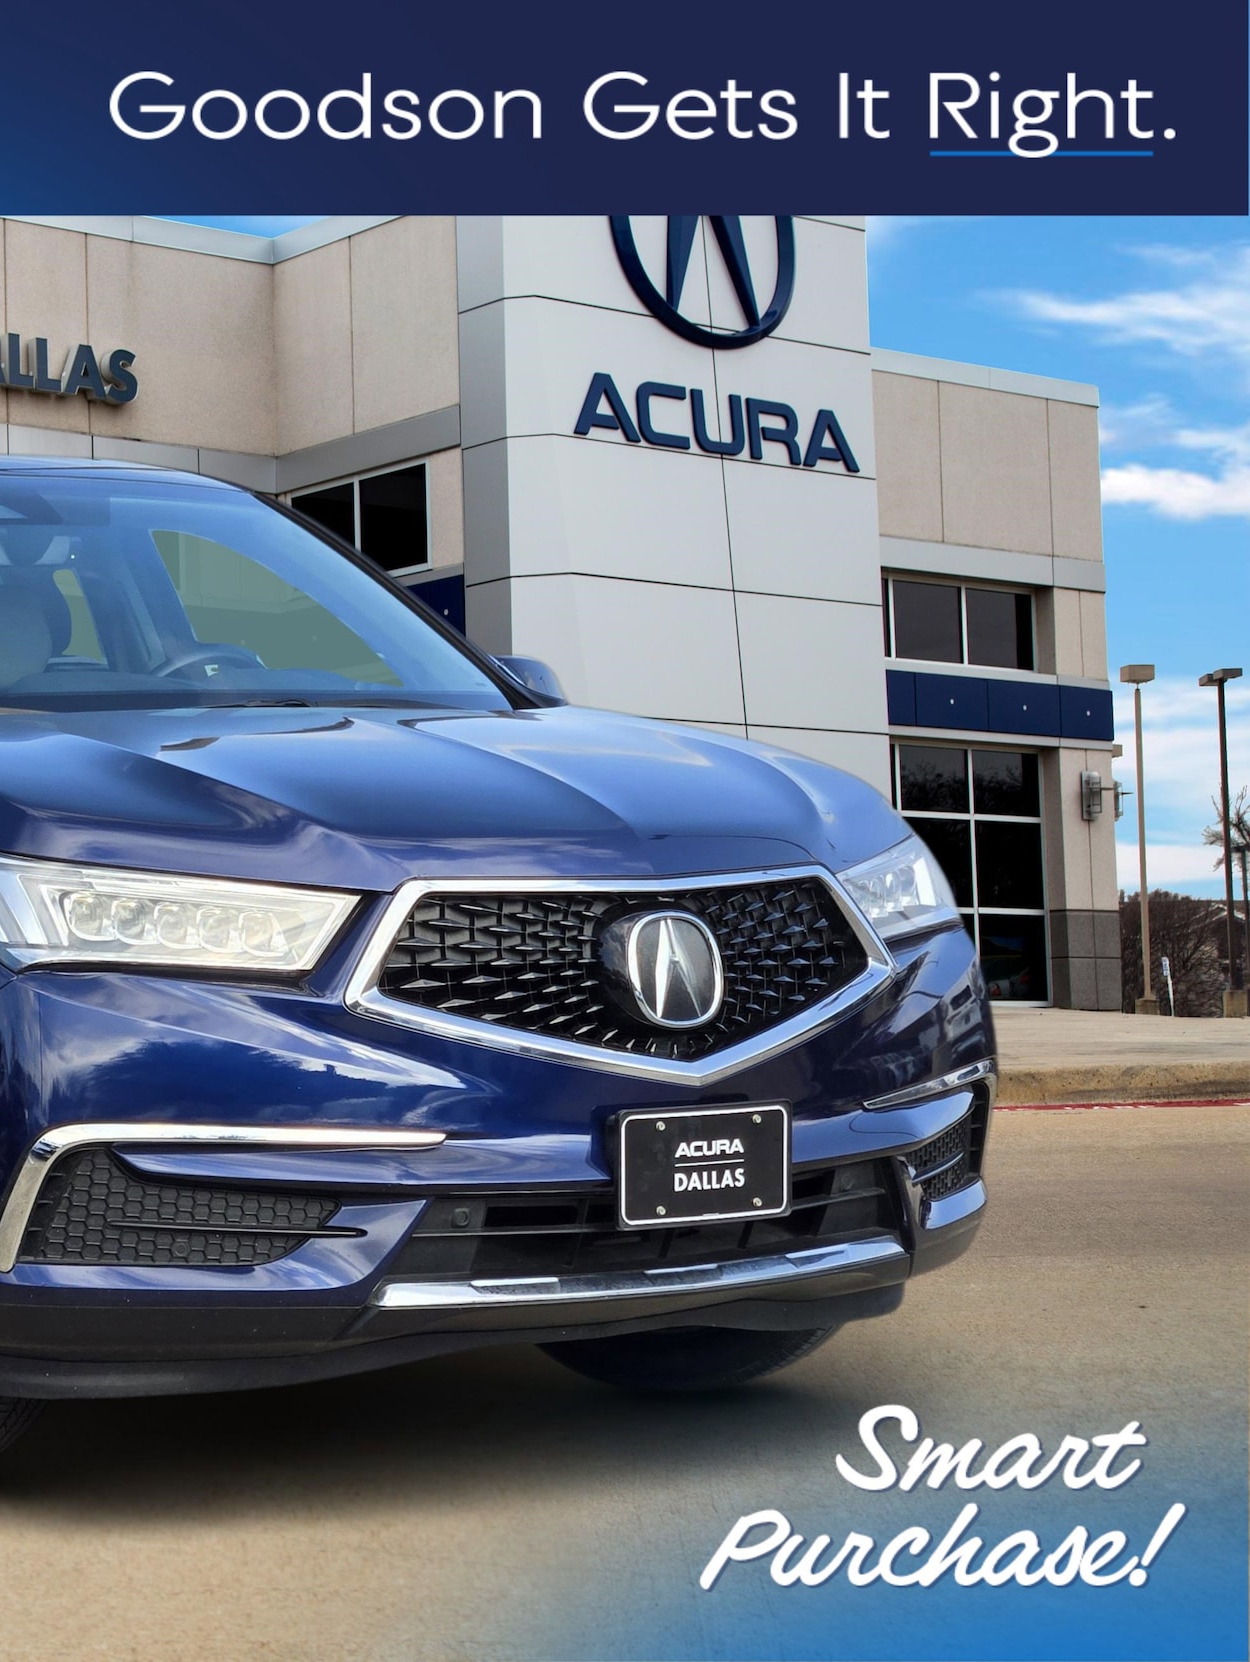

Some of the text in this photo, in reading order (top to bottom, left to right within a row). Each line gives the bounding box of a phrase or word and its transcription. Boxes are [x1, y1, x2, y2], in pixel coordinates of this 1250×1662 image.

[573, 371, 860, 474] ACURA
[674, 1138, 745, 1158] ACURA
[674, 1168, 746, 1192] DALLAS
